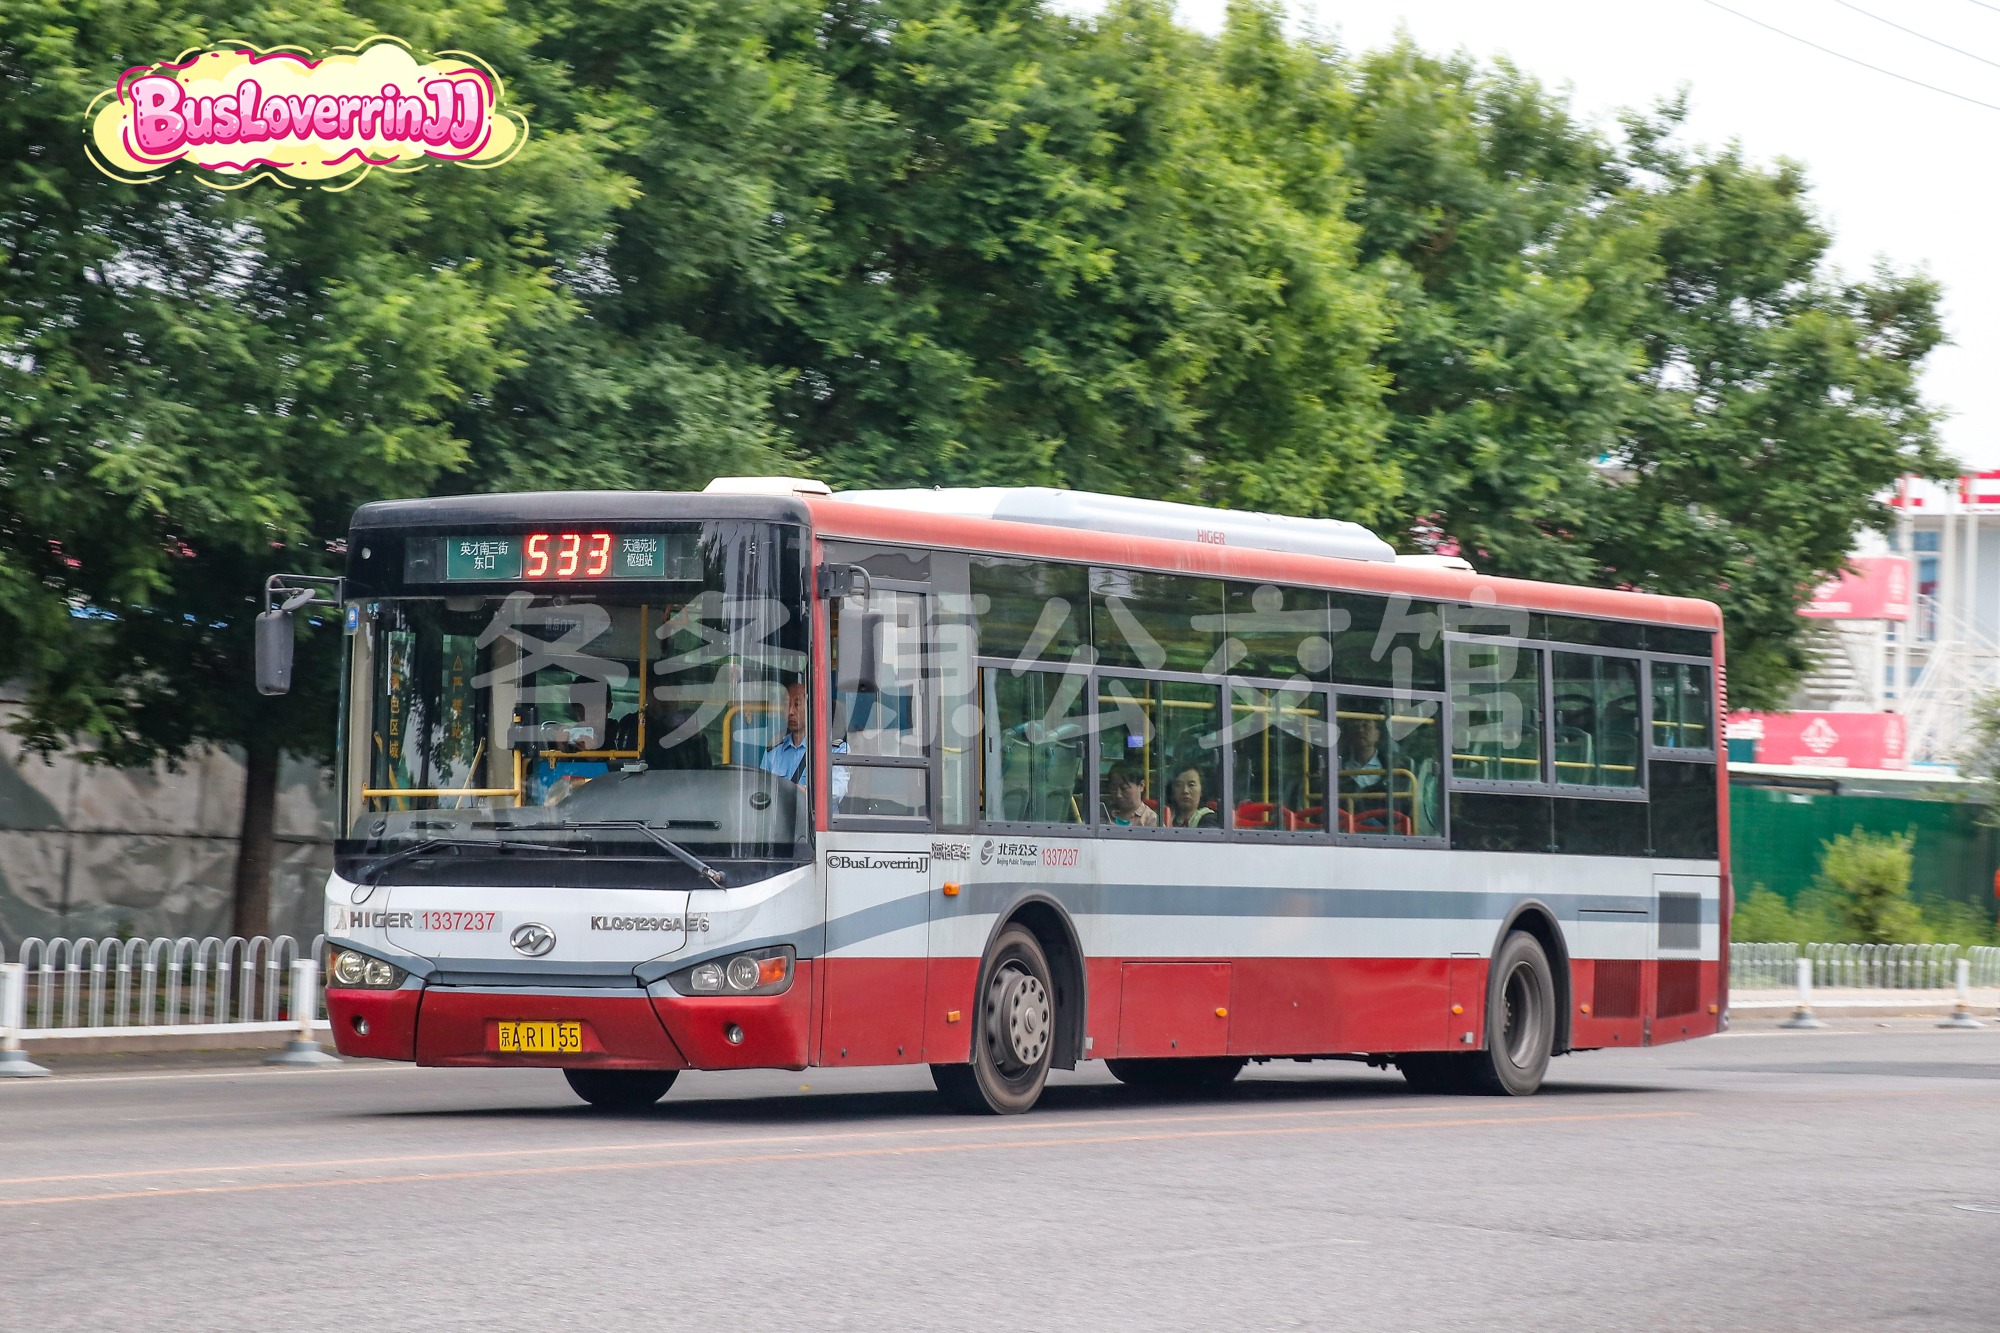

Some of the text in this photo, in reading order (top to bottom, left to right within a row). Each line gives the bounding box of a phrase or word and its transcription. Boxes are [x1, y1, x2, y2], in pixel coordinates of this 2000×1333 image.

[1197, 529, 1226, 545] HIGER
[460, 541, 509, 556] 英才南三街
[622, 538, 657, 553] 天通苑北
[473, 555, 495, 570] 东口
[527, 534, 611, 577] 533
[626, 553, 653, 567] 枢纽站
[997, 843, 1038, 857] 北京公交
[1041, 848, 1079, 866] 1337237
[1009, 858, 1019, 866] Public
[1020, 859, 1037, 867] Transport
[350, 911, 414, 929] HIGER
[421, 912, 496, 931] 1337237
